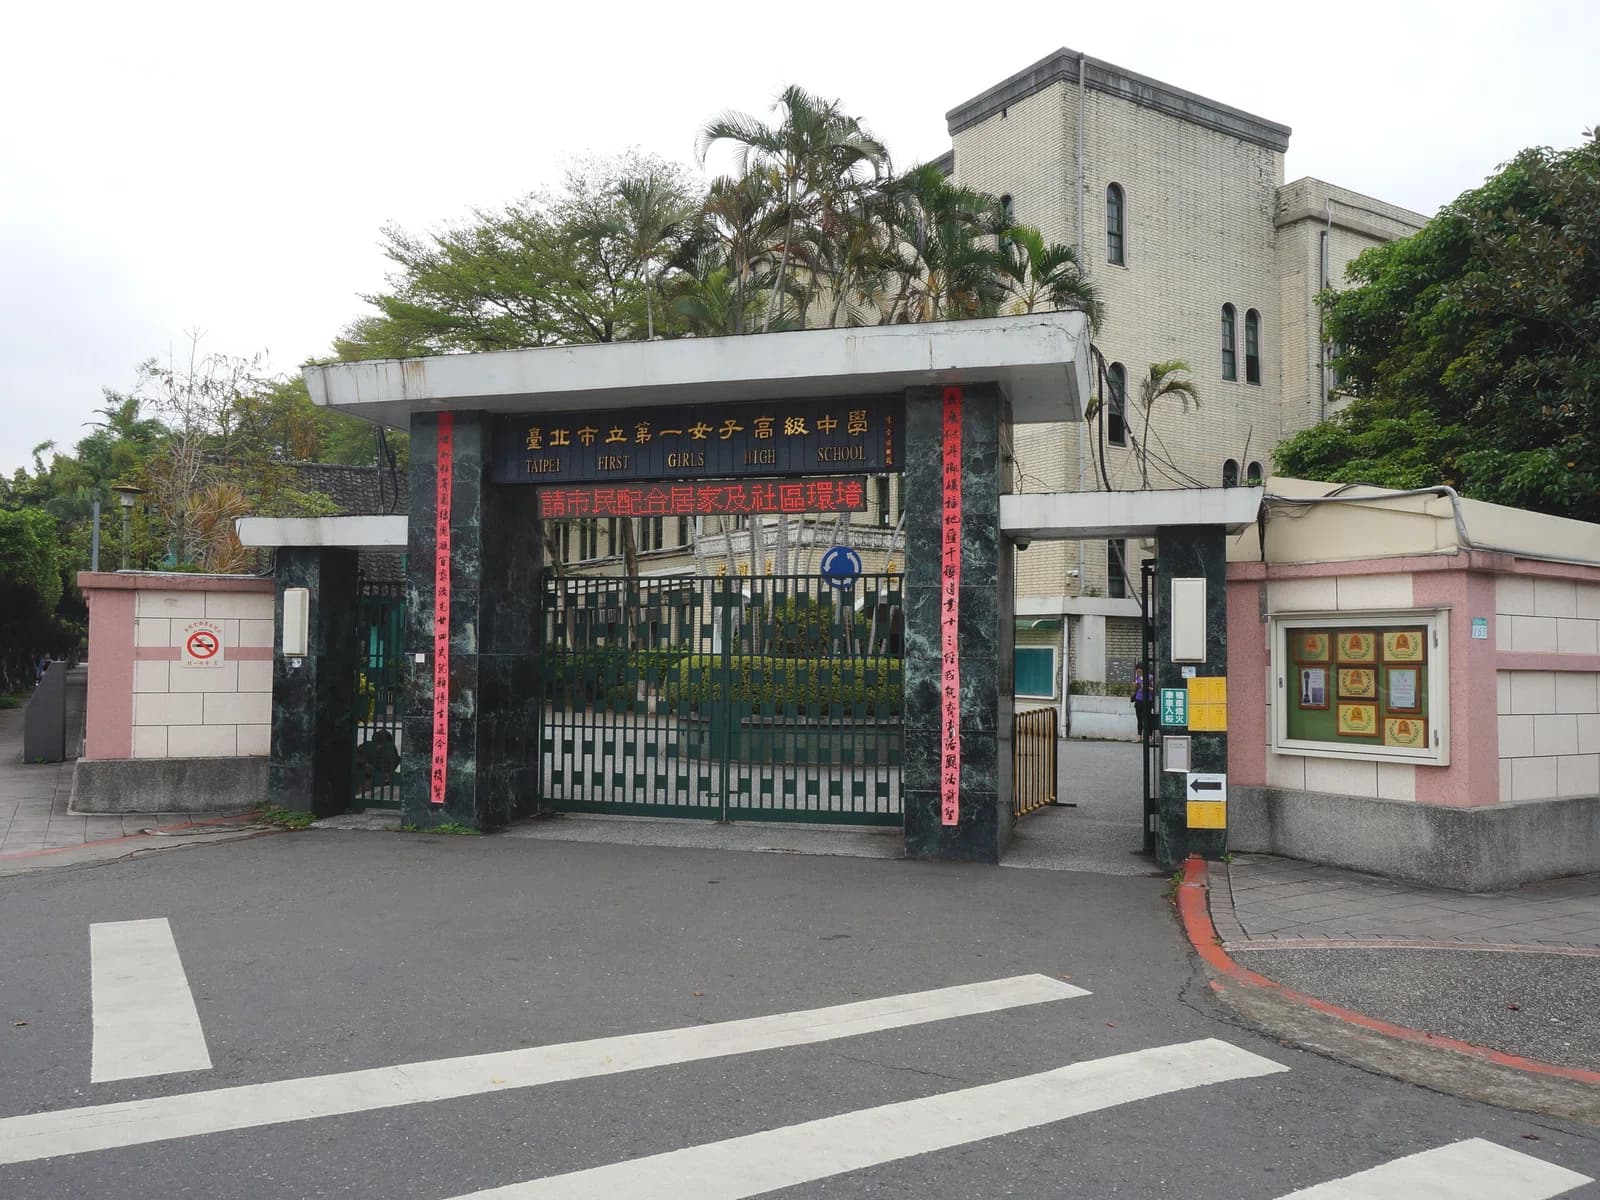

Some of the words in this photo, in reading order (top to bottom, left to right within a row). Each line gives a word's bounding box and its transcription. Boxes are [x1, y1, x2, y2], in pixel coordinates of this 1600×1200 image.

[526, 410, 869, 450] 臺北市立第一女子高級中學
[525, 458, 560, 473] TAIPEI
[598, 455, 629, 471] FIRST
[667, 452, 704, 468] GIRLS
[744, 449, 776, 465] HIGH
[817, 445, 866, 462] SCHOOL
